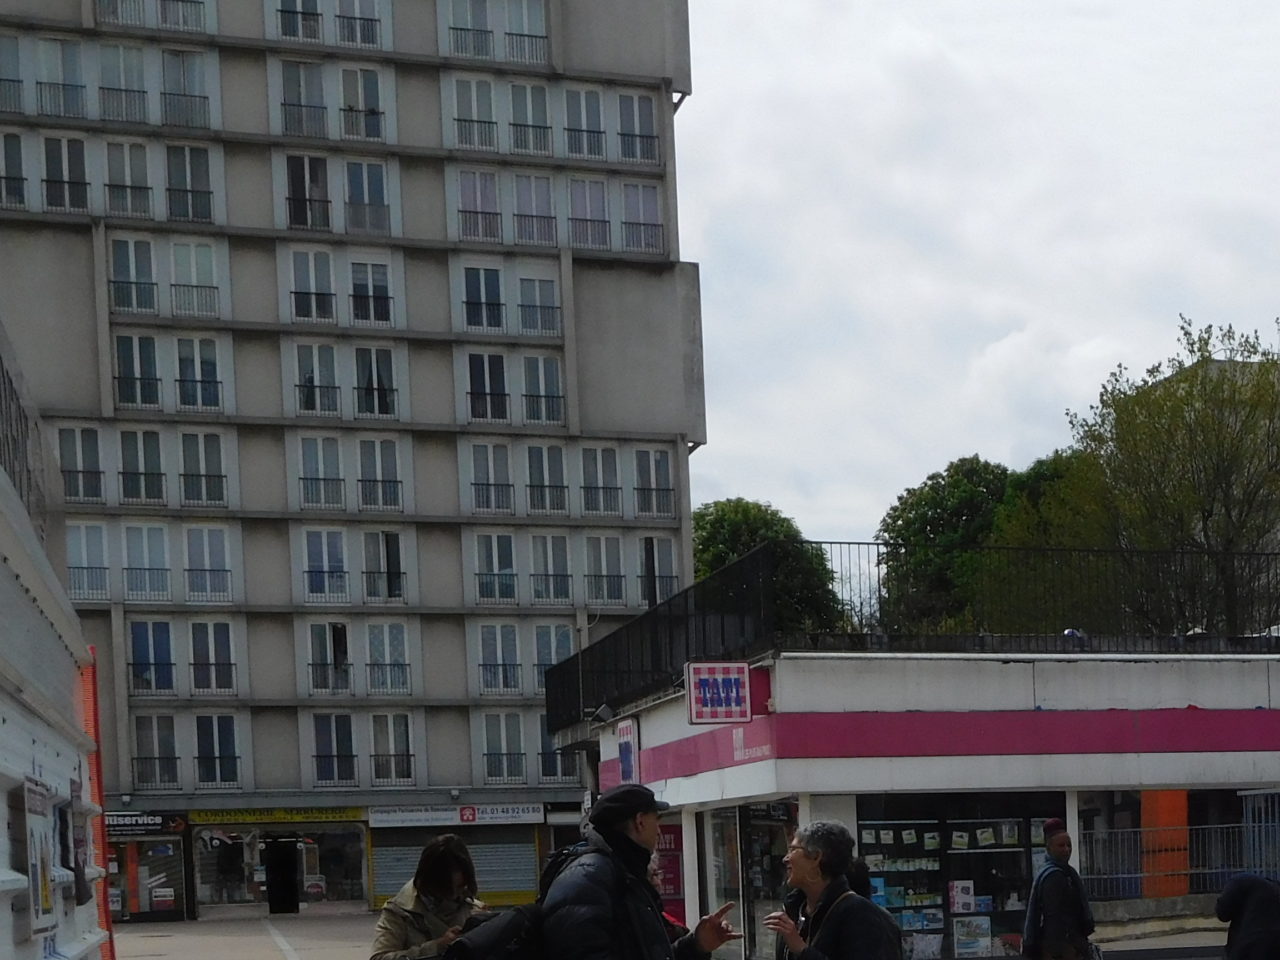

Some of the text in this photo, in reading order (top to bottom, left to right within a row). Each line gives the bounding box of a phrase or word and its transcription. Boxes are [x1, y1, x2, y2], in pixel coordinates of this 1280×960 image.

[698, 678, 742, 707] TATI
[490, 807, 498, 815] 01
[512, 806, 520, 814] 92
